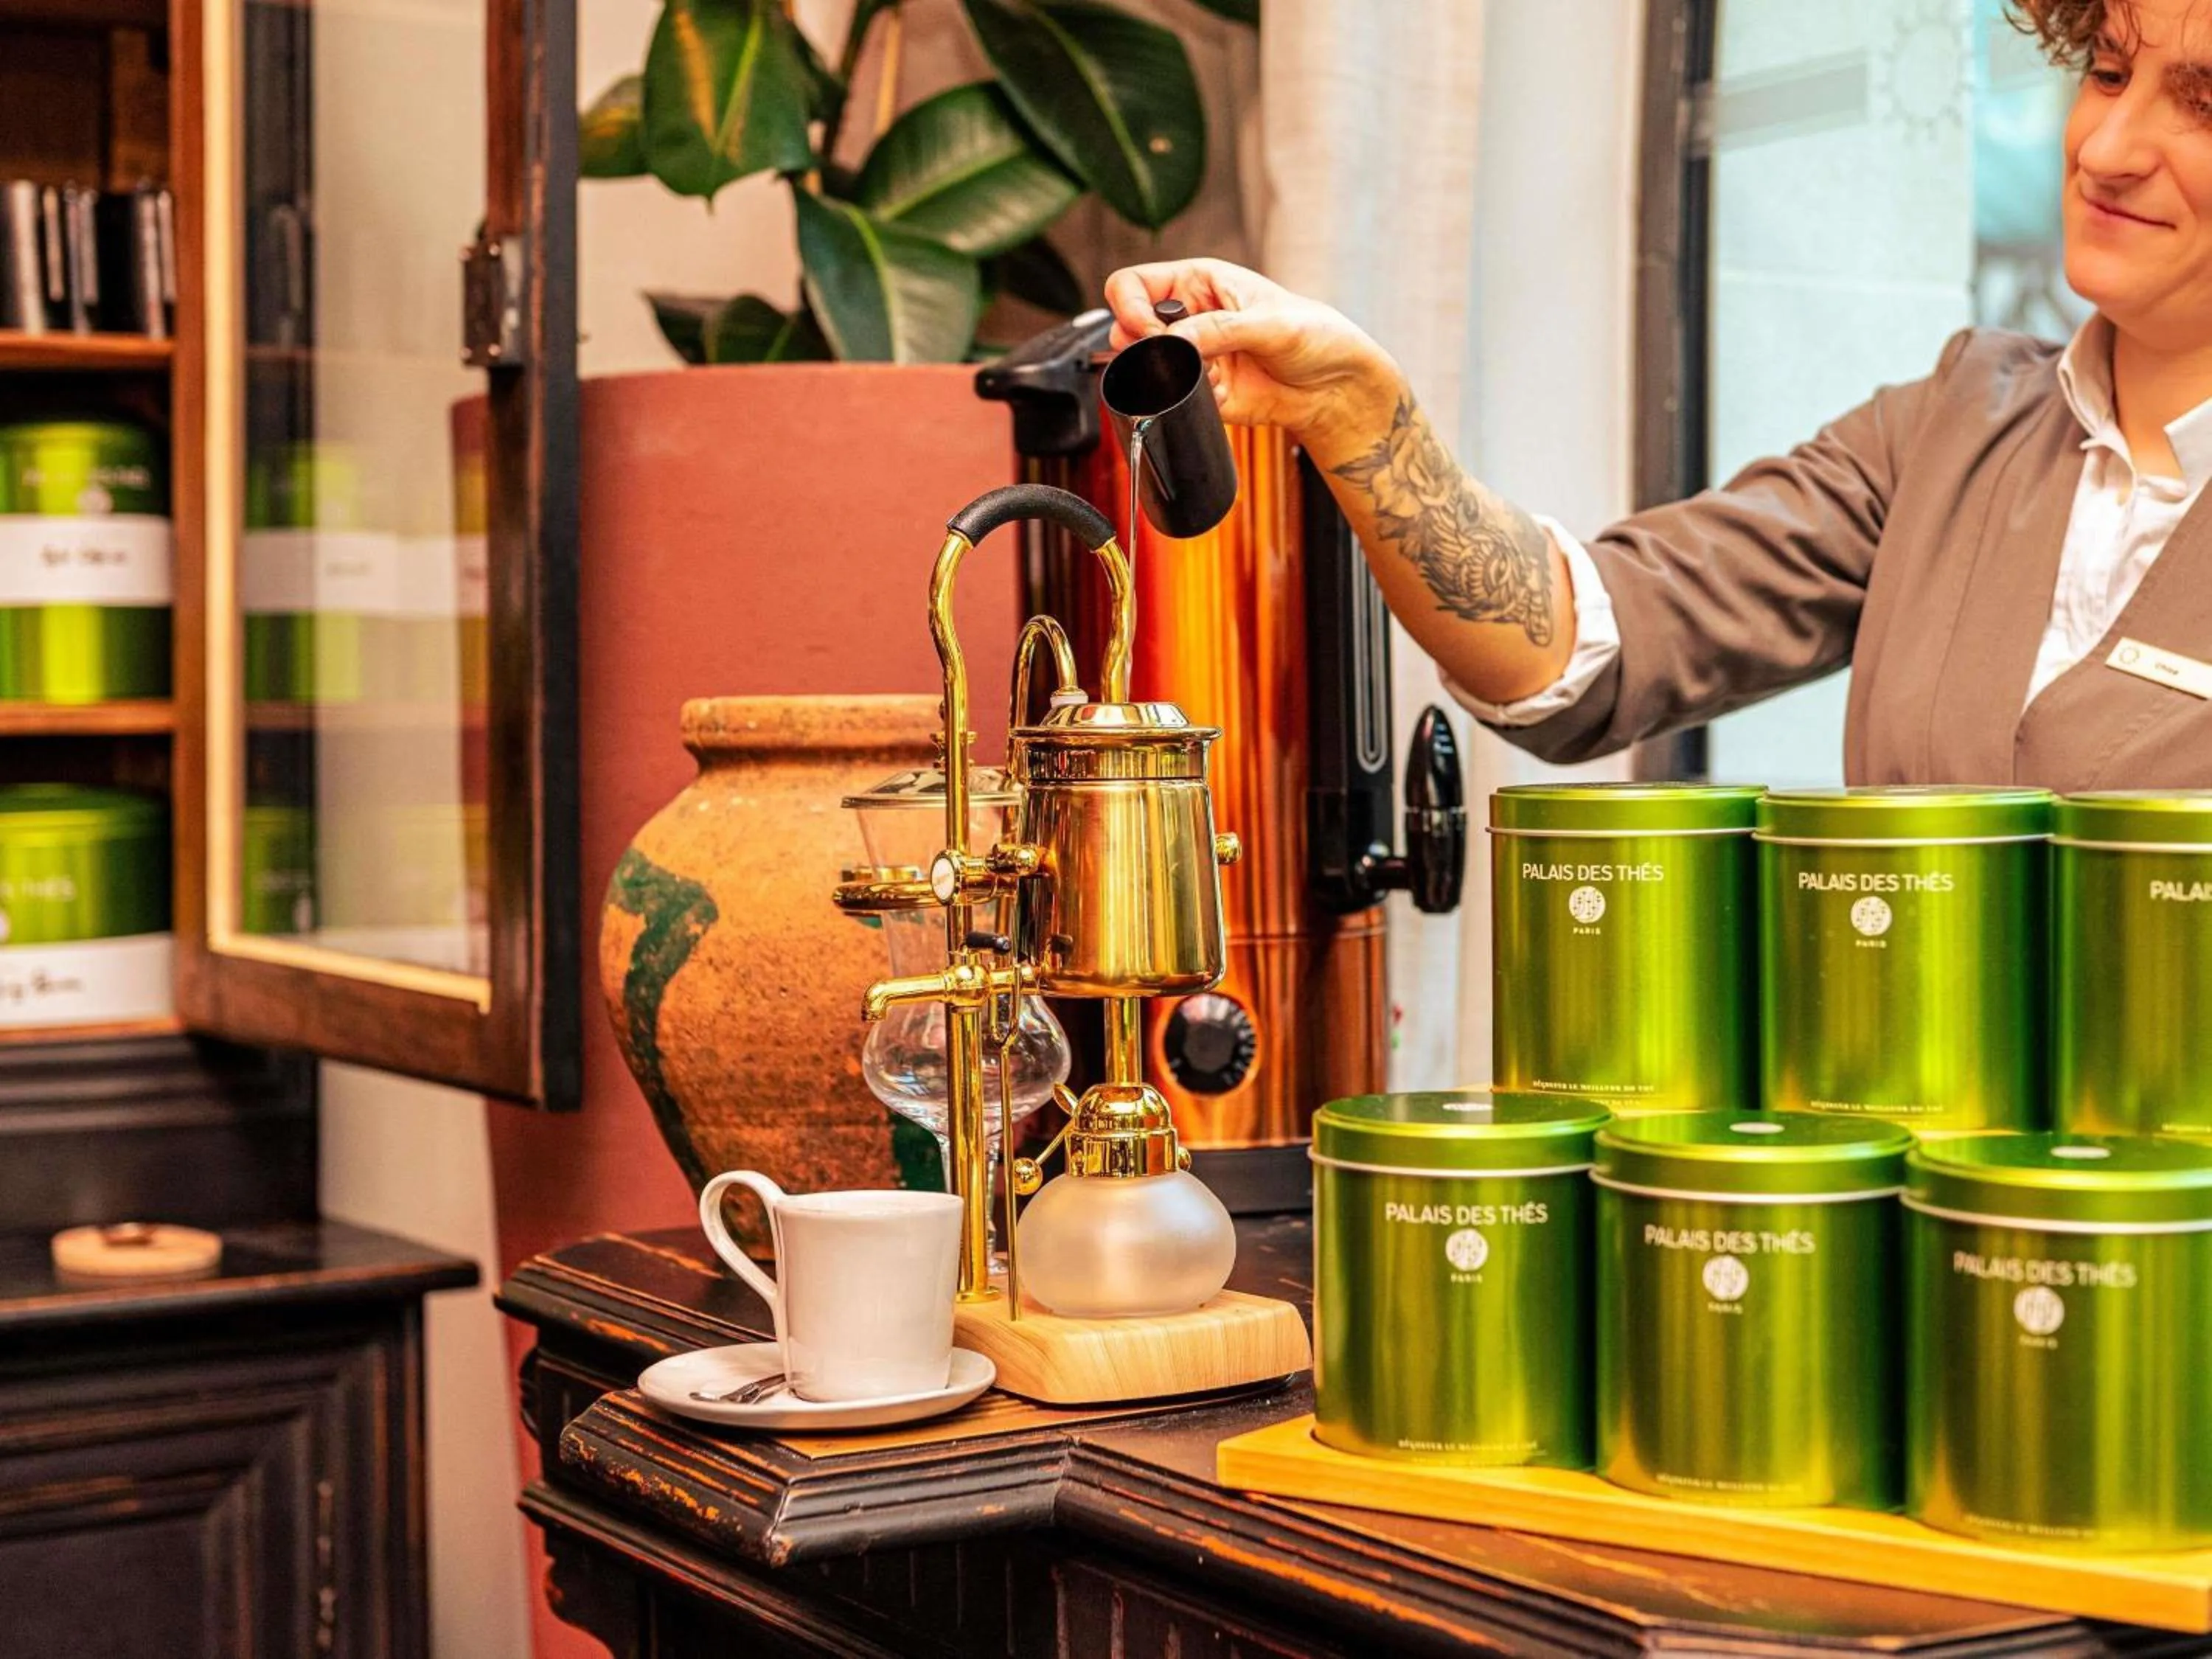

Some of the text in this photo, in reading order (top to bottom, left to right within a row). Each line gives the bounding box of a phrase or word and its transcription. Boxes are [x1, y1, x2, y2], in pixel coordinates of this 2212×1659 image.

[1522, 861, 1664, 882] PALAIS DES THÉS
[1798, 870, 1955, 892] PALAIS DES THÉS
[1572, 926, 1601, 936] PARIS
[1385, 1201, 1549, 1225] PALAIS DES THÉS
[1644, 1223, 1817, 1254] PALAIS DES THÉS
[1953, 1250, 2025, 1283] PALAIS
[2025, 1259, 2075, 1287] DES
